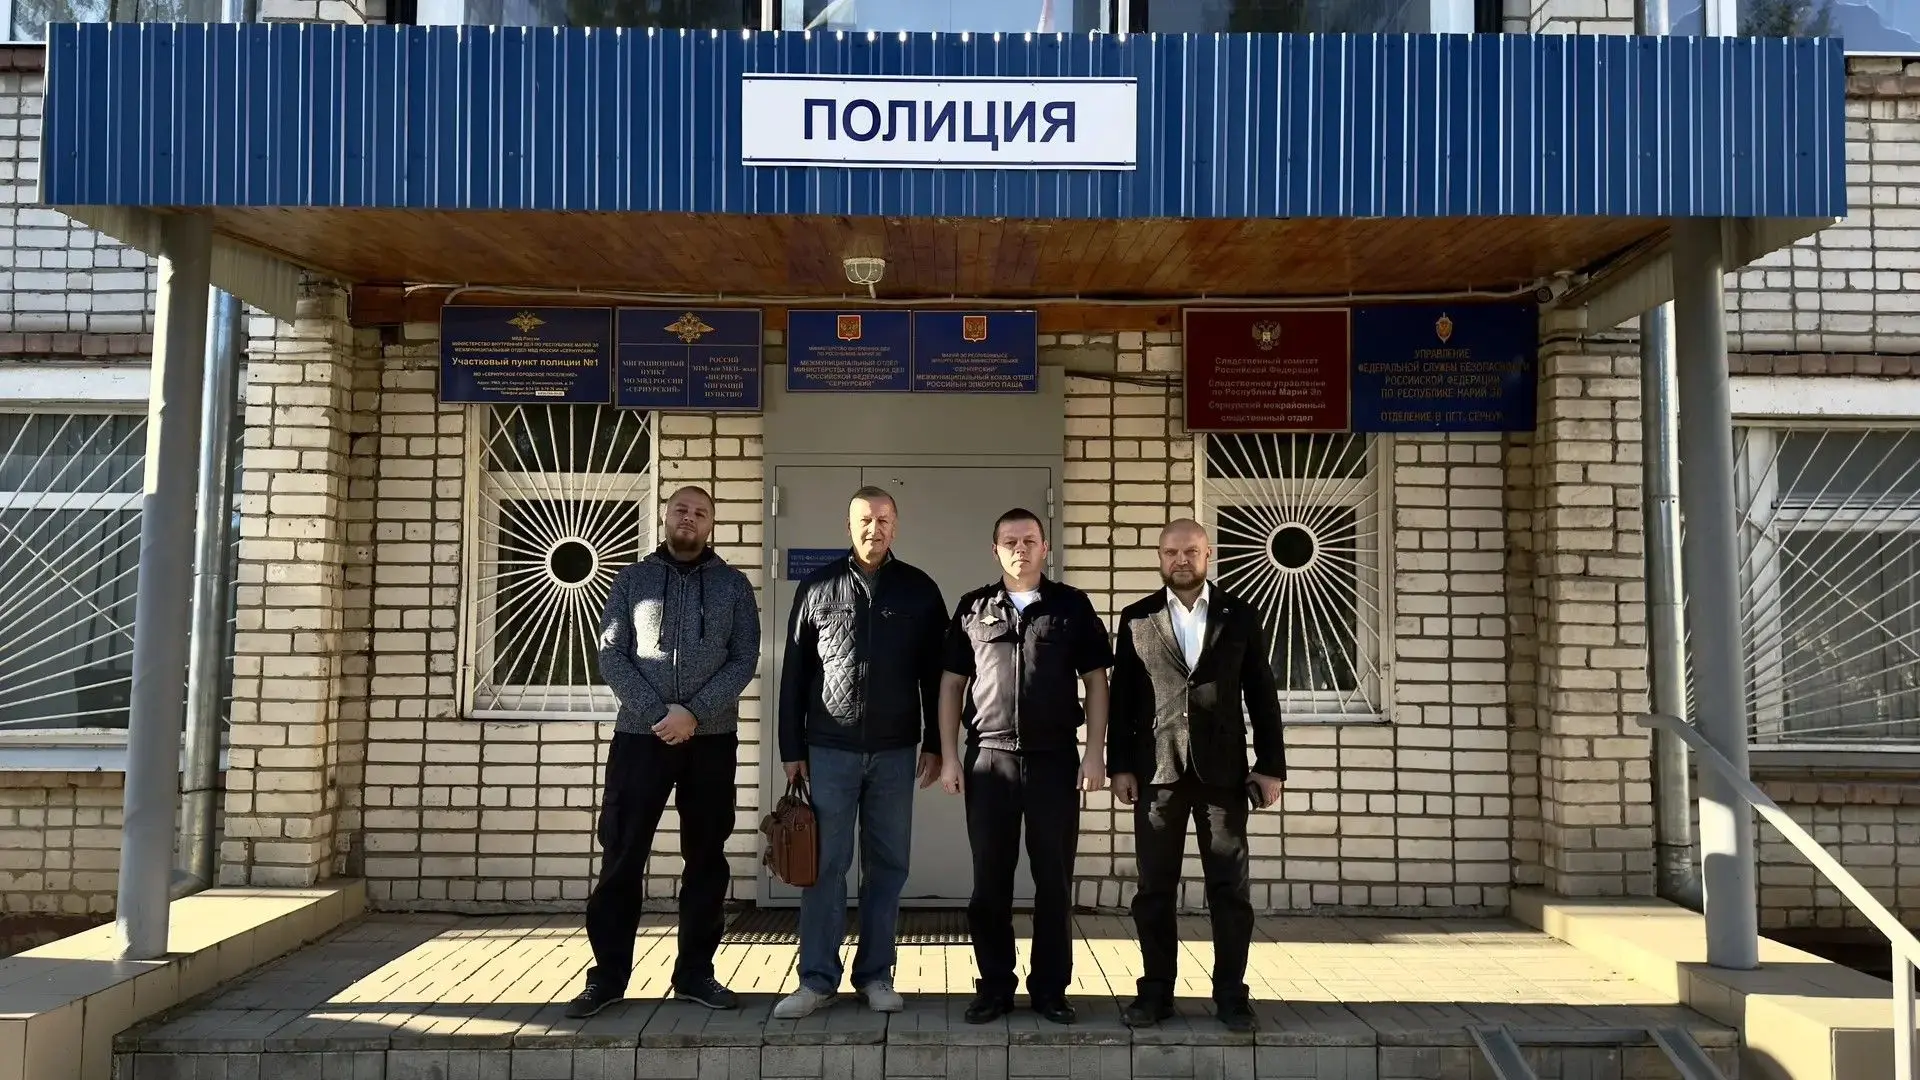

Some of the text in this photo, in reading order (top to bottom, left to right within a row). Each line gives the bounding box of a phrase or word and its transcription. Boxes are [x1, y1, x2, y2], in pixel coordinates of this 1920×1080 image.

[803, 98, 1076, 151] ПОЛИЦИЯ
[1414, 348, 1471, 358] УПРАВЛЕНИЕ
[452, 357, 599, 367] Участковый пункт полиции №1
[1215, 357, 1281, 365] Следственный
[1269, 366, 1319, 374] Федерации
[1358, 361, 1419, 373] ФЕДЕРАЛЬНОЙ
[1273, 380, 1326, 389] управление
[1385, 375, 1444, 385] РОССИЙСКОЙ
[1225, 388, 1277, 397] Республике
[1279, 388, 1308, 397] Марий
[1381, 388, 1394, 397] ПО
[1397, 388, 1453, 398] РЕСПУБЛИКЕ
[1263, 401, 1326, 410] межрайонный
[1287, 415, 1313, 423] отдел
[1381, 412, 1432, 422] ОТДЕЛЕНИЕ
